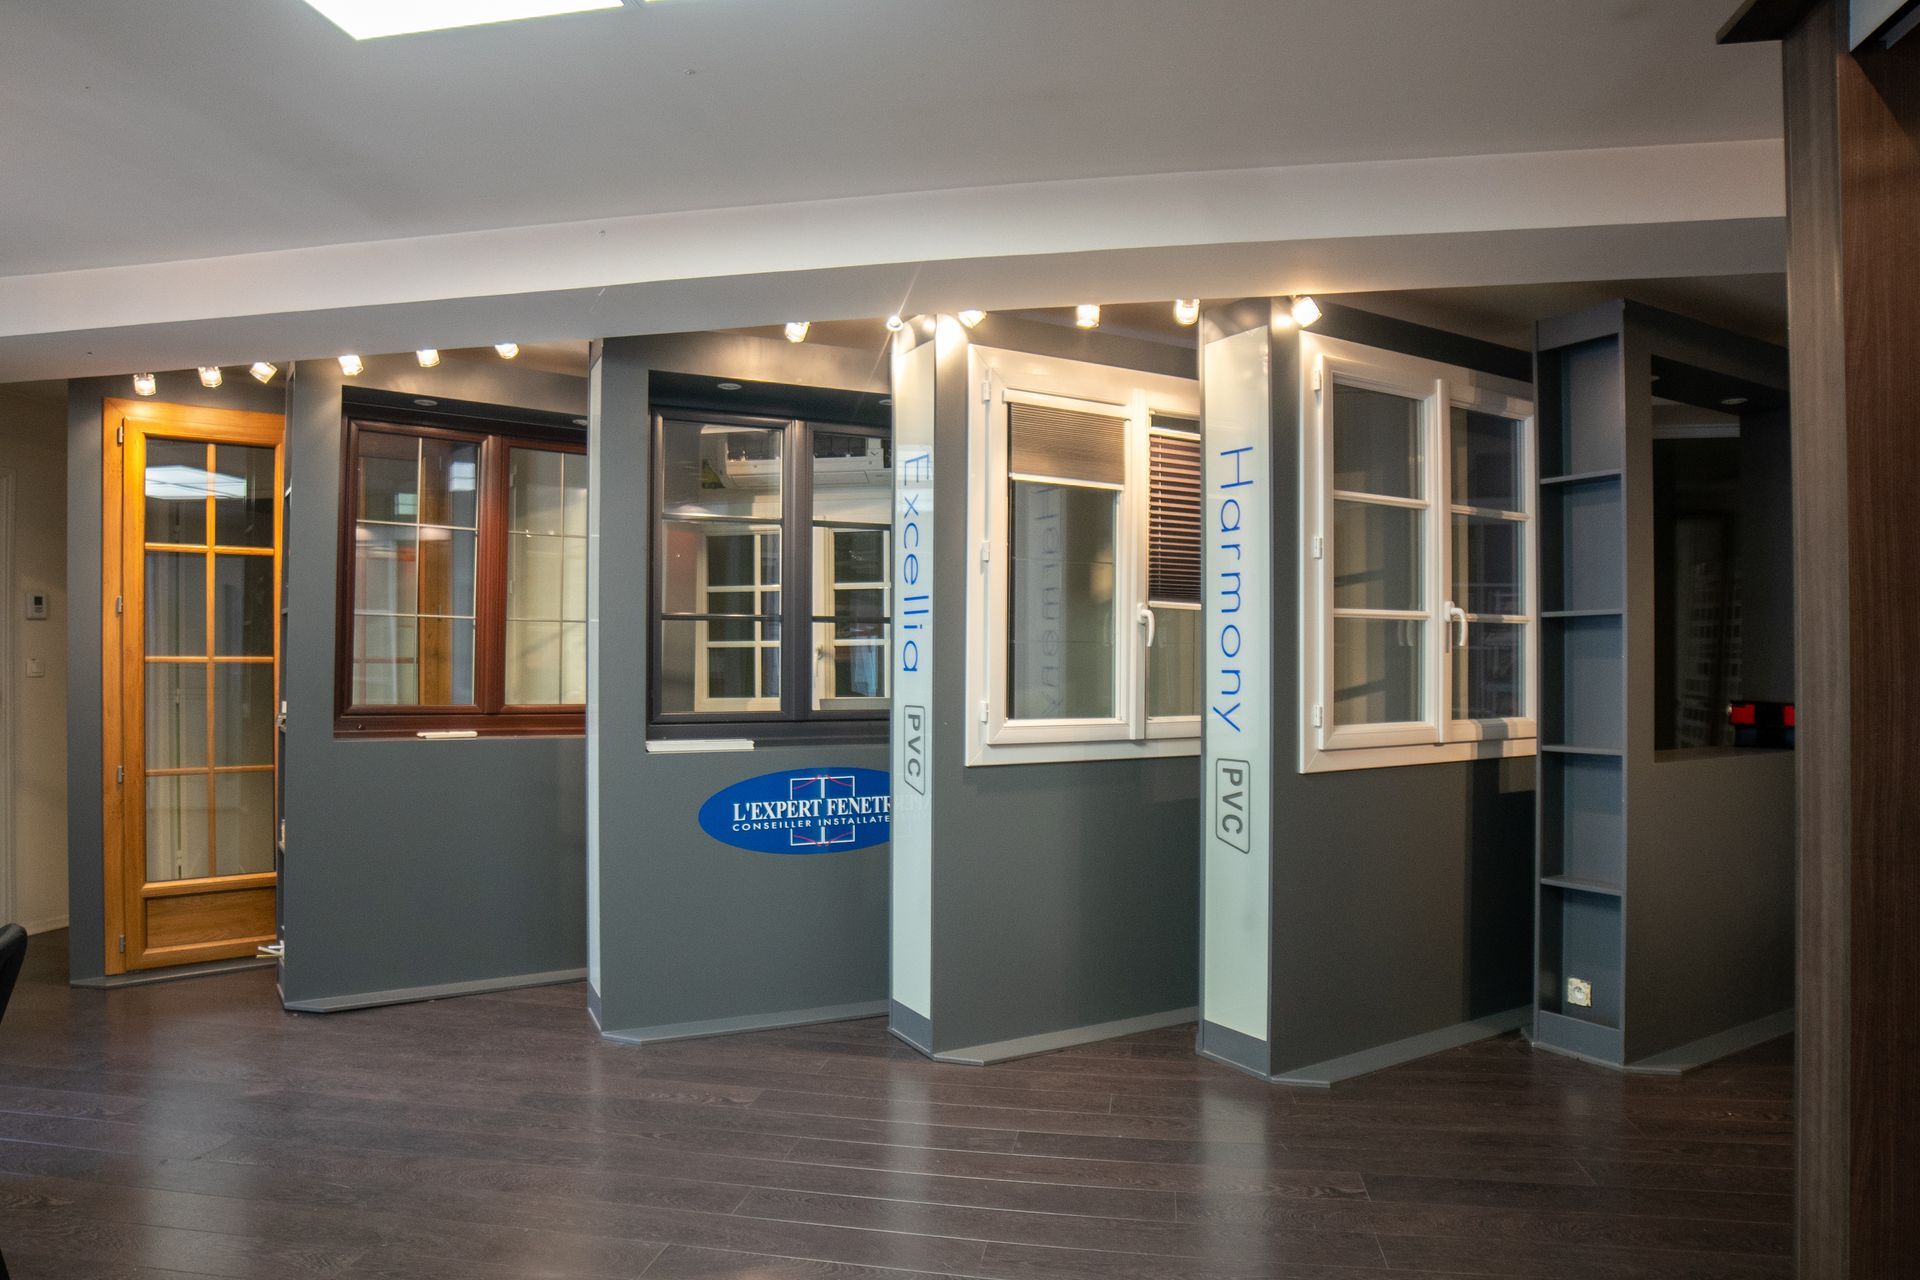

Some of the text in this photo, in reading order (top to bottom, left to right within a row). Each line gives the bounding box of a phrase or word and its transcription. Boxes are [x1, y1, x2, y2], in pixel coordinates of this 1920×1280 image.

[903, 454, 929, 672] Excellia
[1213, 446, 1253, 732] Harmony
[907, 713, 921, 778] PVC
[732, 815, 890, 831] CONSEILLER INSTALLATE
[733, 799, 822, 821] L'EXPERT
[1222, 767, 1243, 835] PVC
